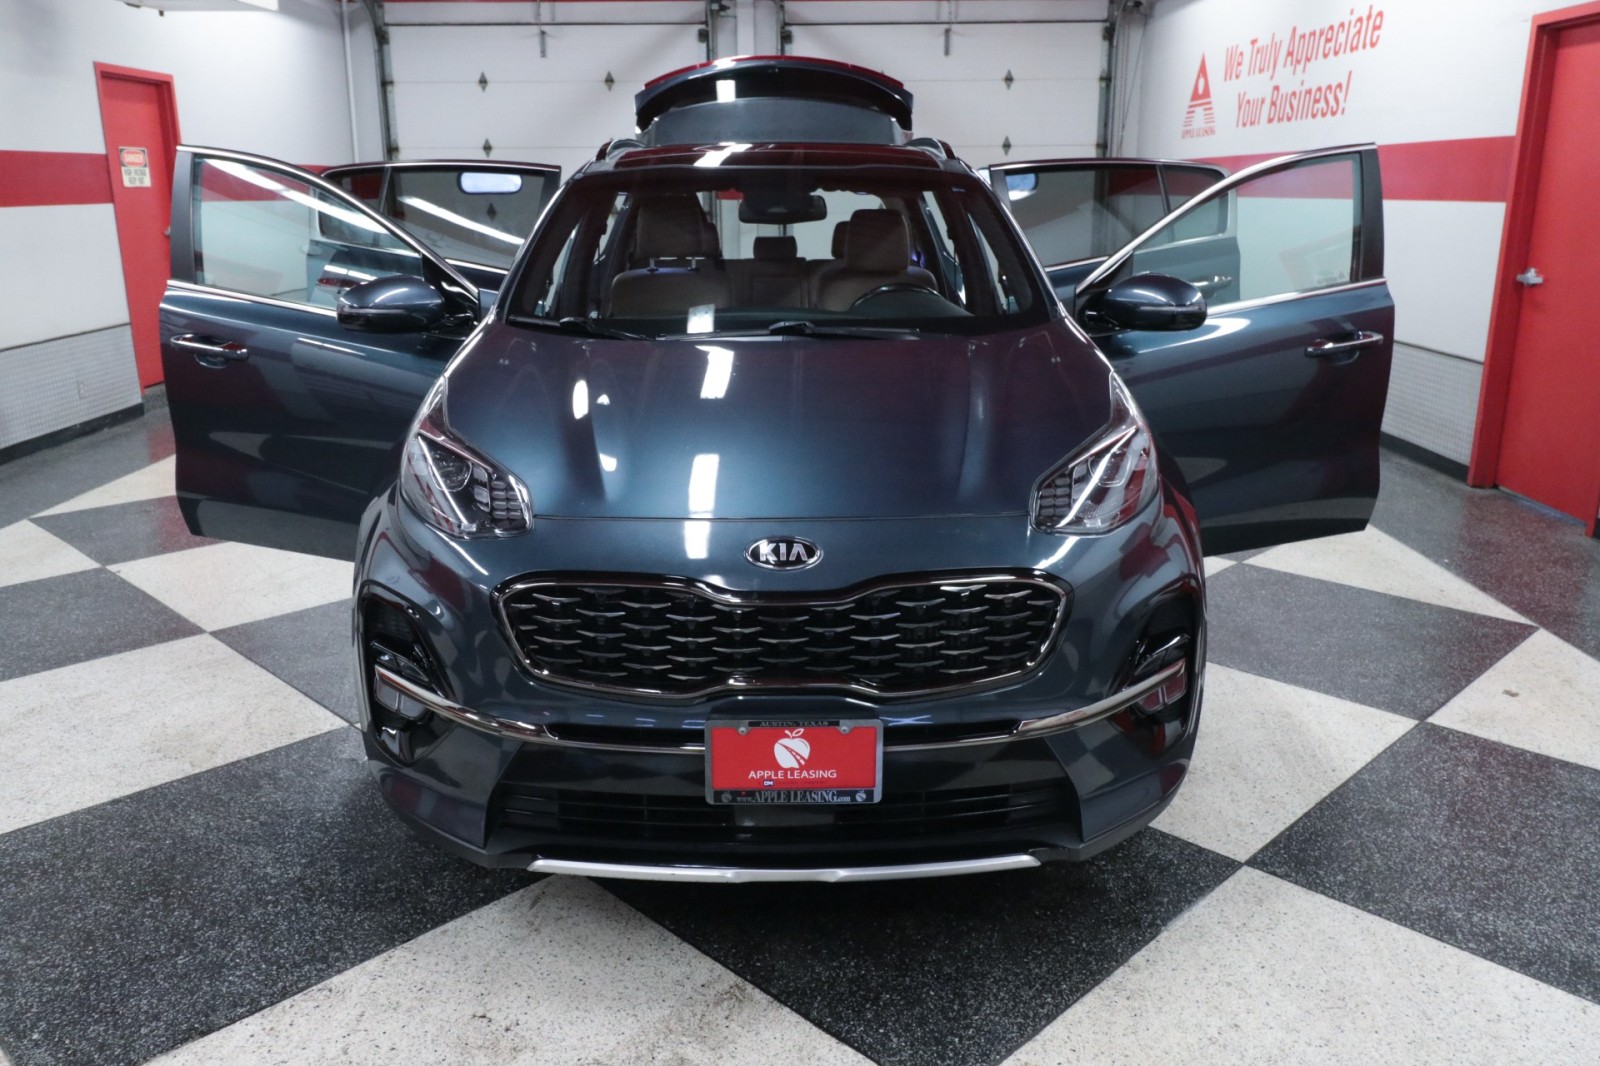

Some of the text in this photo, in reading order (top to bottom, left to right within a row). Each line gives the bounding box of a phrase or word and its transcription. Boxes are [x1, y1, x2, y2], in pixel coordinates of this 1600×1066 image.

[1224, 4, 1384, 82] We Truly Appreciate
[1236, 70, 1353, 128] Your Business!
[759, 542, 808, 562] KIA
[749, 769, 837, 779] APPLE LEASING
